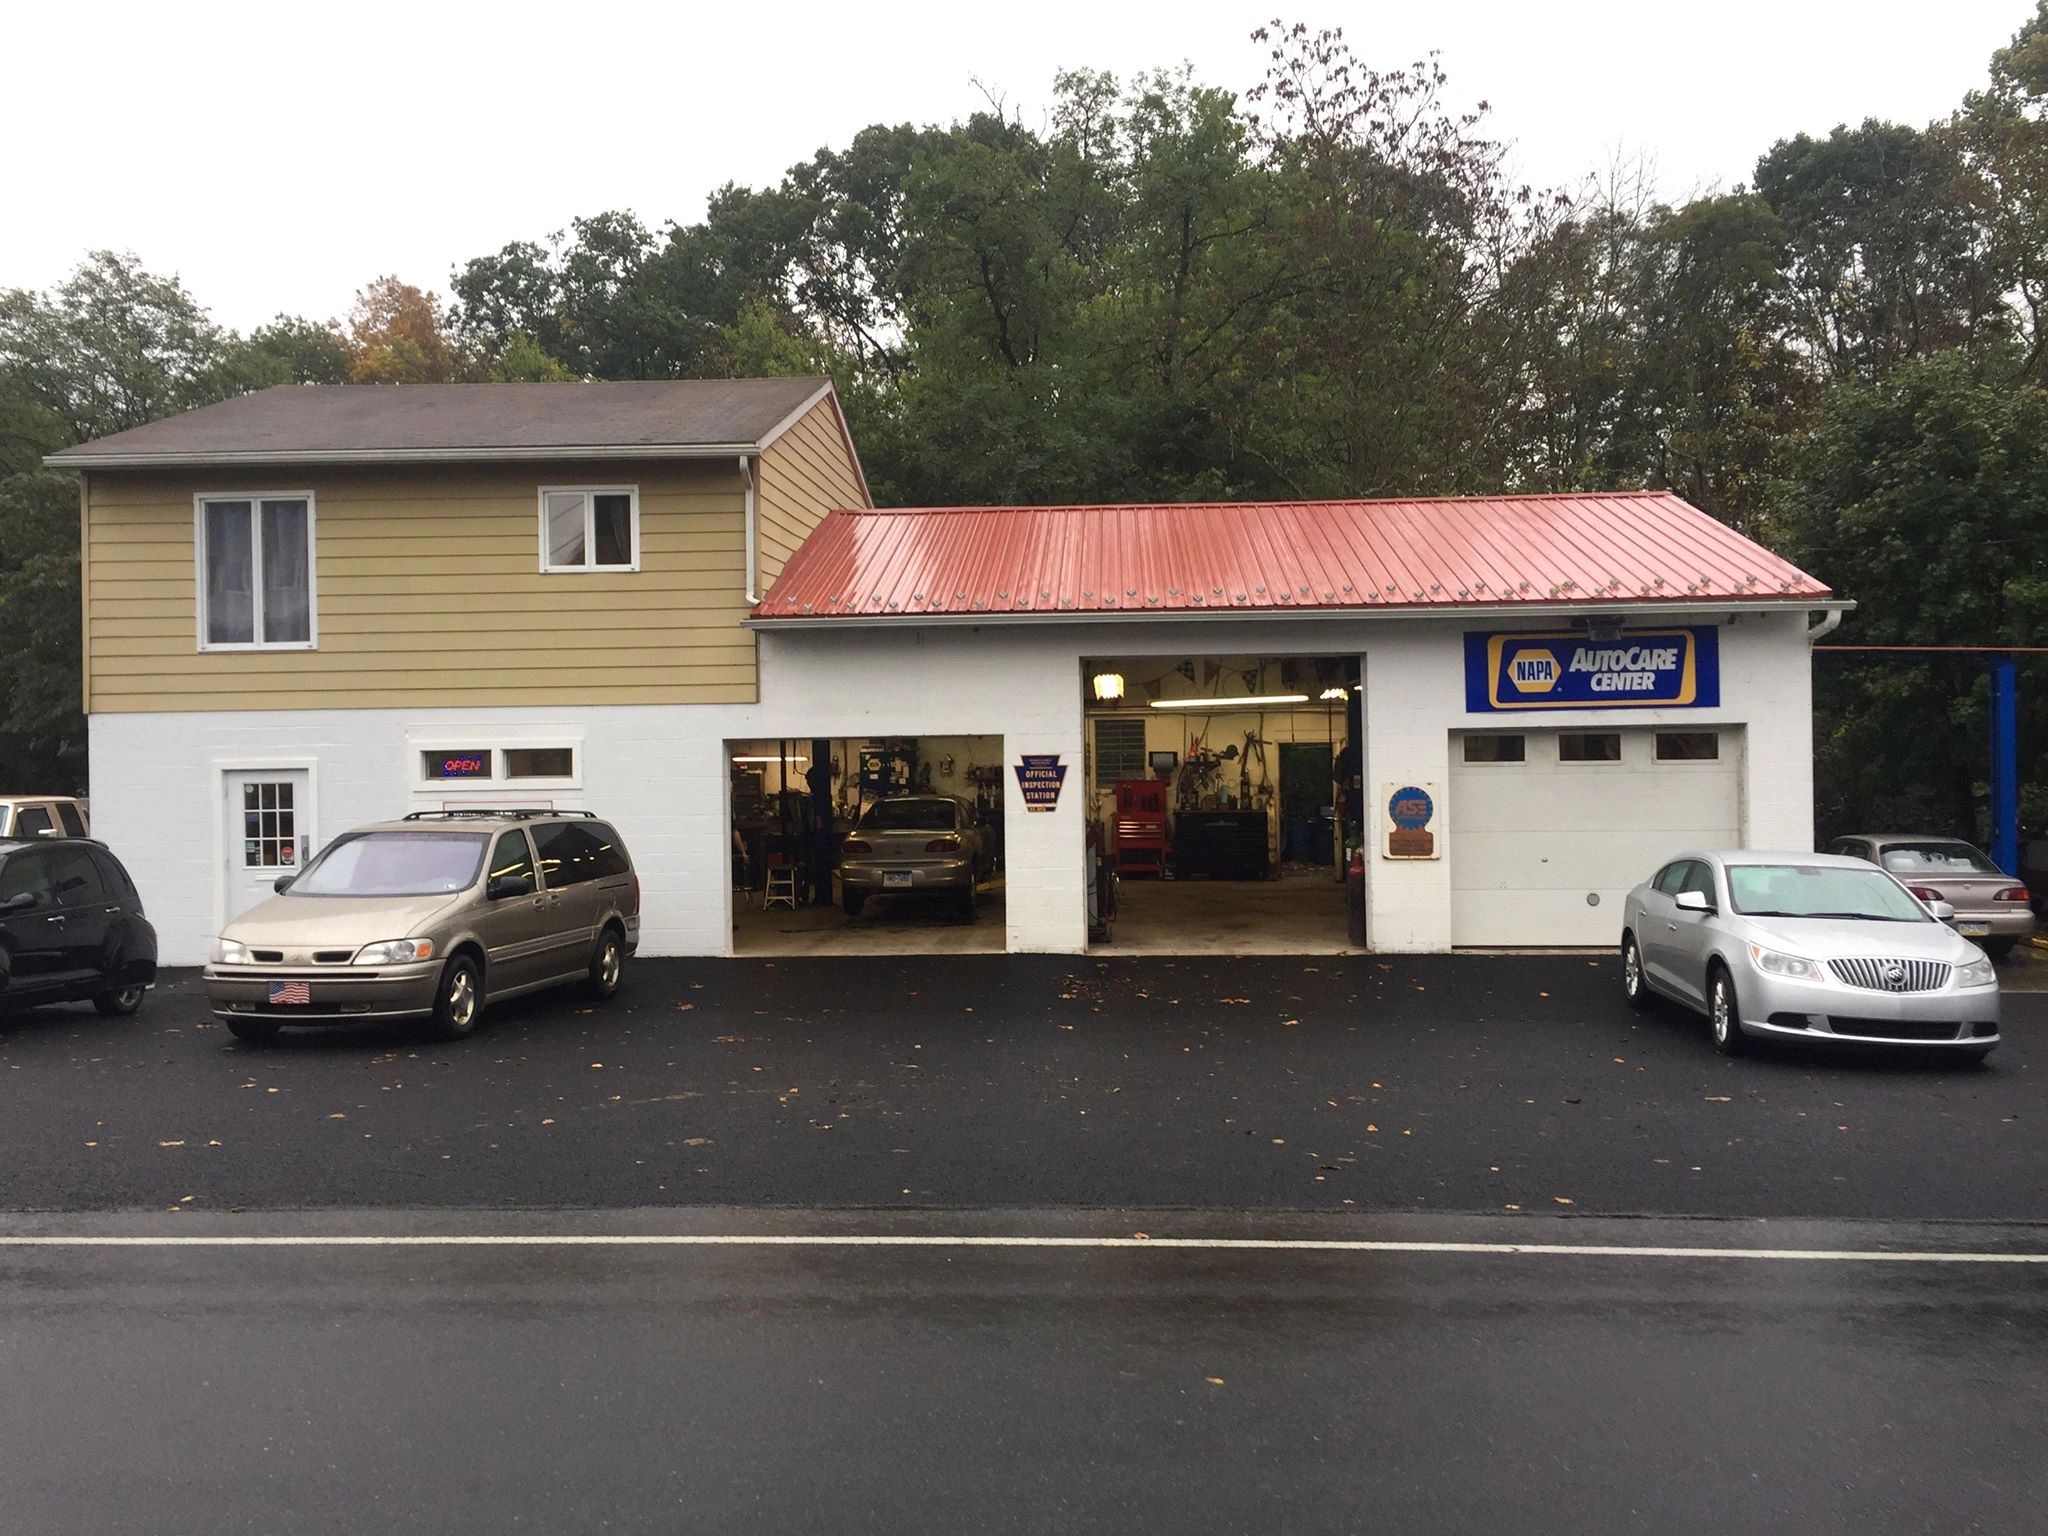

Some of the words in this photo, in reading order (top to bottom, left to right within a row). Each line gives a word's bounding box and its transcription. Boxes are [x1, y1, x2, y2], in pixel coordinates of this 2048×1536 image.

[1516, 660, 1553, 681] NAPA
[1590, 672, 1656, 692] CENTER
[445, 760, 480, 771] OPEN
[1025, 770, 1057, 778] OFFICIAL
[1021, 781, 1061, 789] INSPECTION
[1395, 799, 1427, 818] ASE
